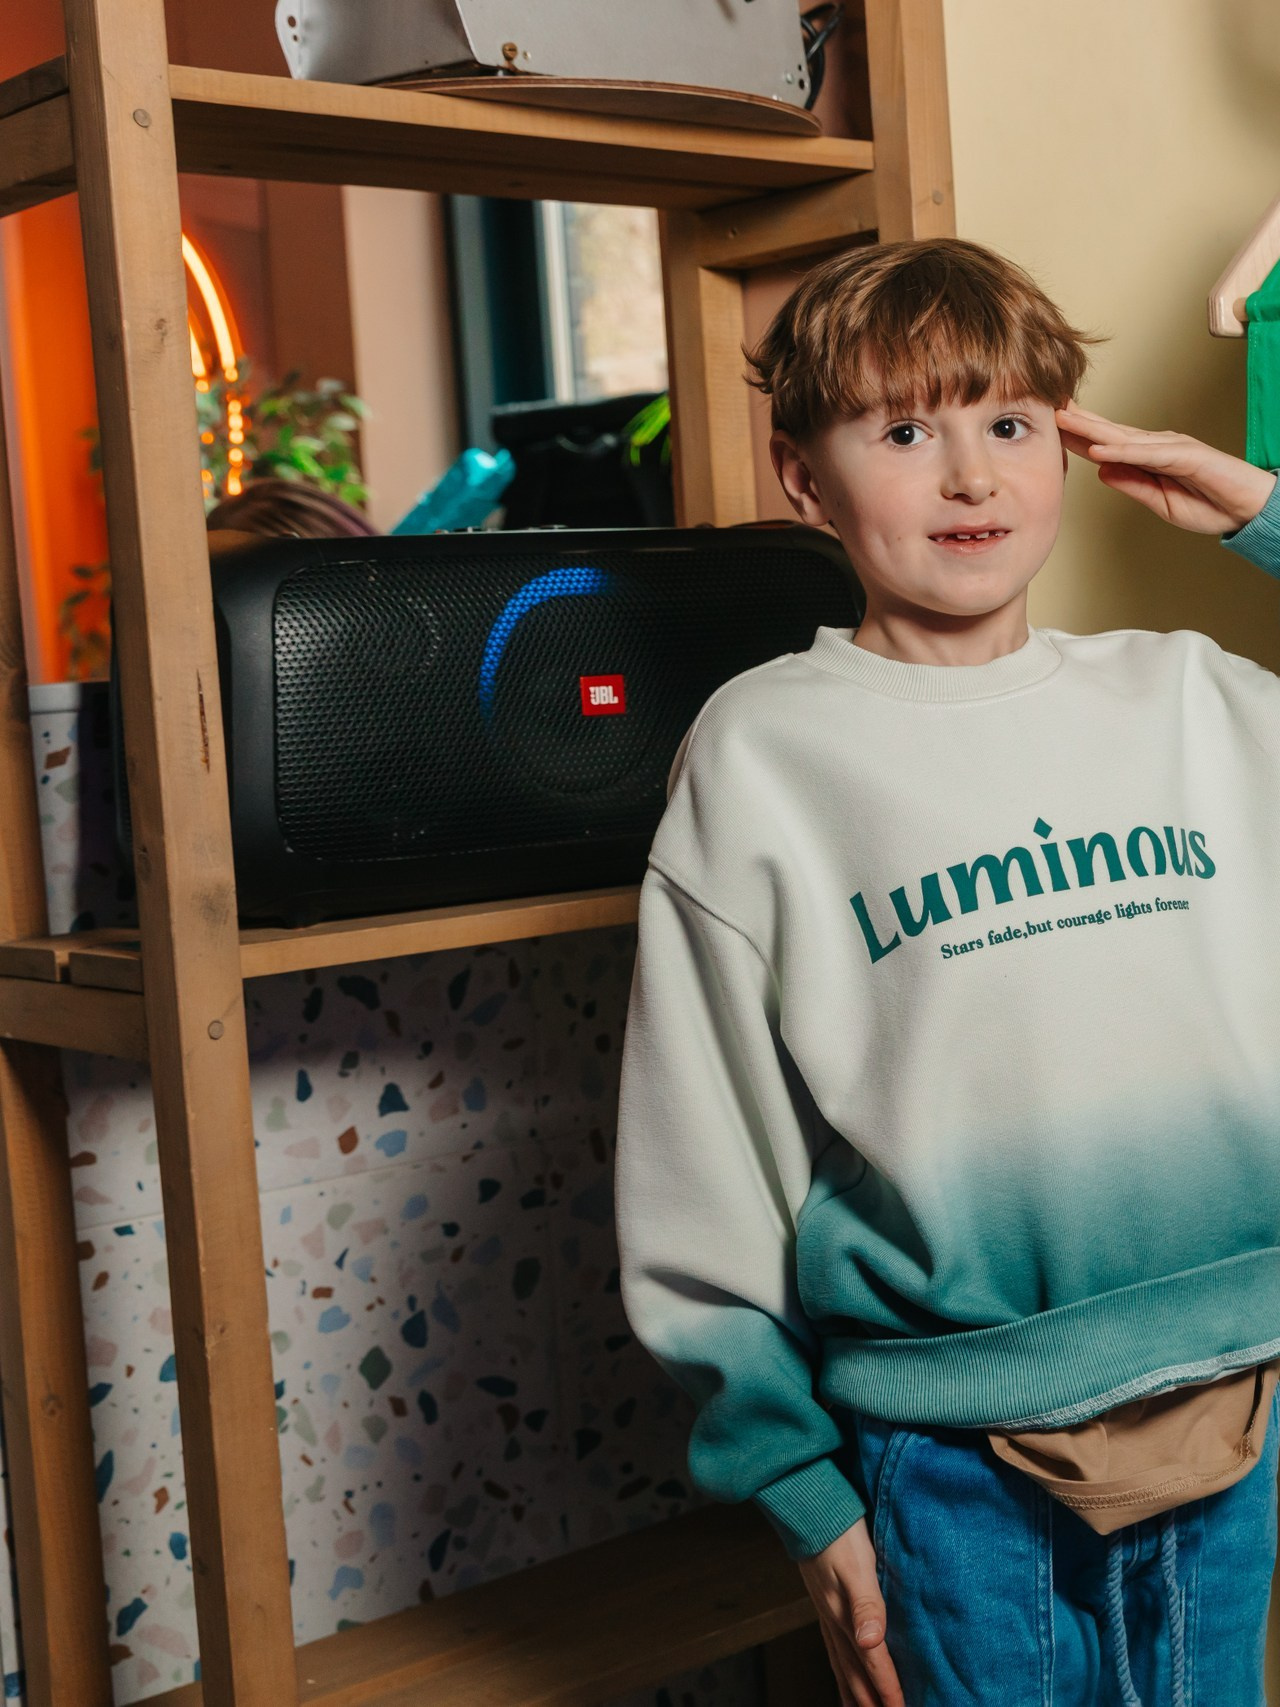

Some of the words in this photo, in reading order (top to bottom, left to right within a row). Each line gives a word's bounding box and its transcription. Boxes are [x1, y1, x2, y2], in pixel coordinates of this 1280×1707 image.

[589, 685, 619, 705] JBL
[849, 817, 1216, 964] Luminous
[941, 938, 984, 959] Stars
[1057, 909, 1112, 929] courage
[1114, 901, 1152, 919] lights
